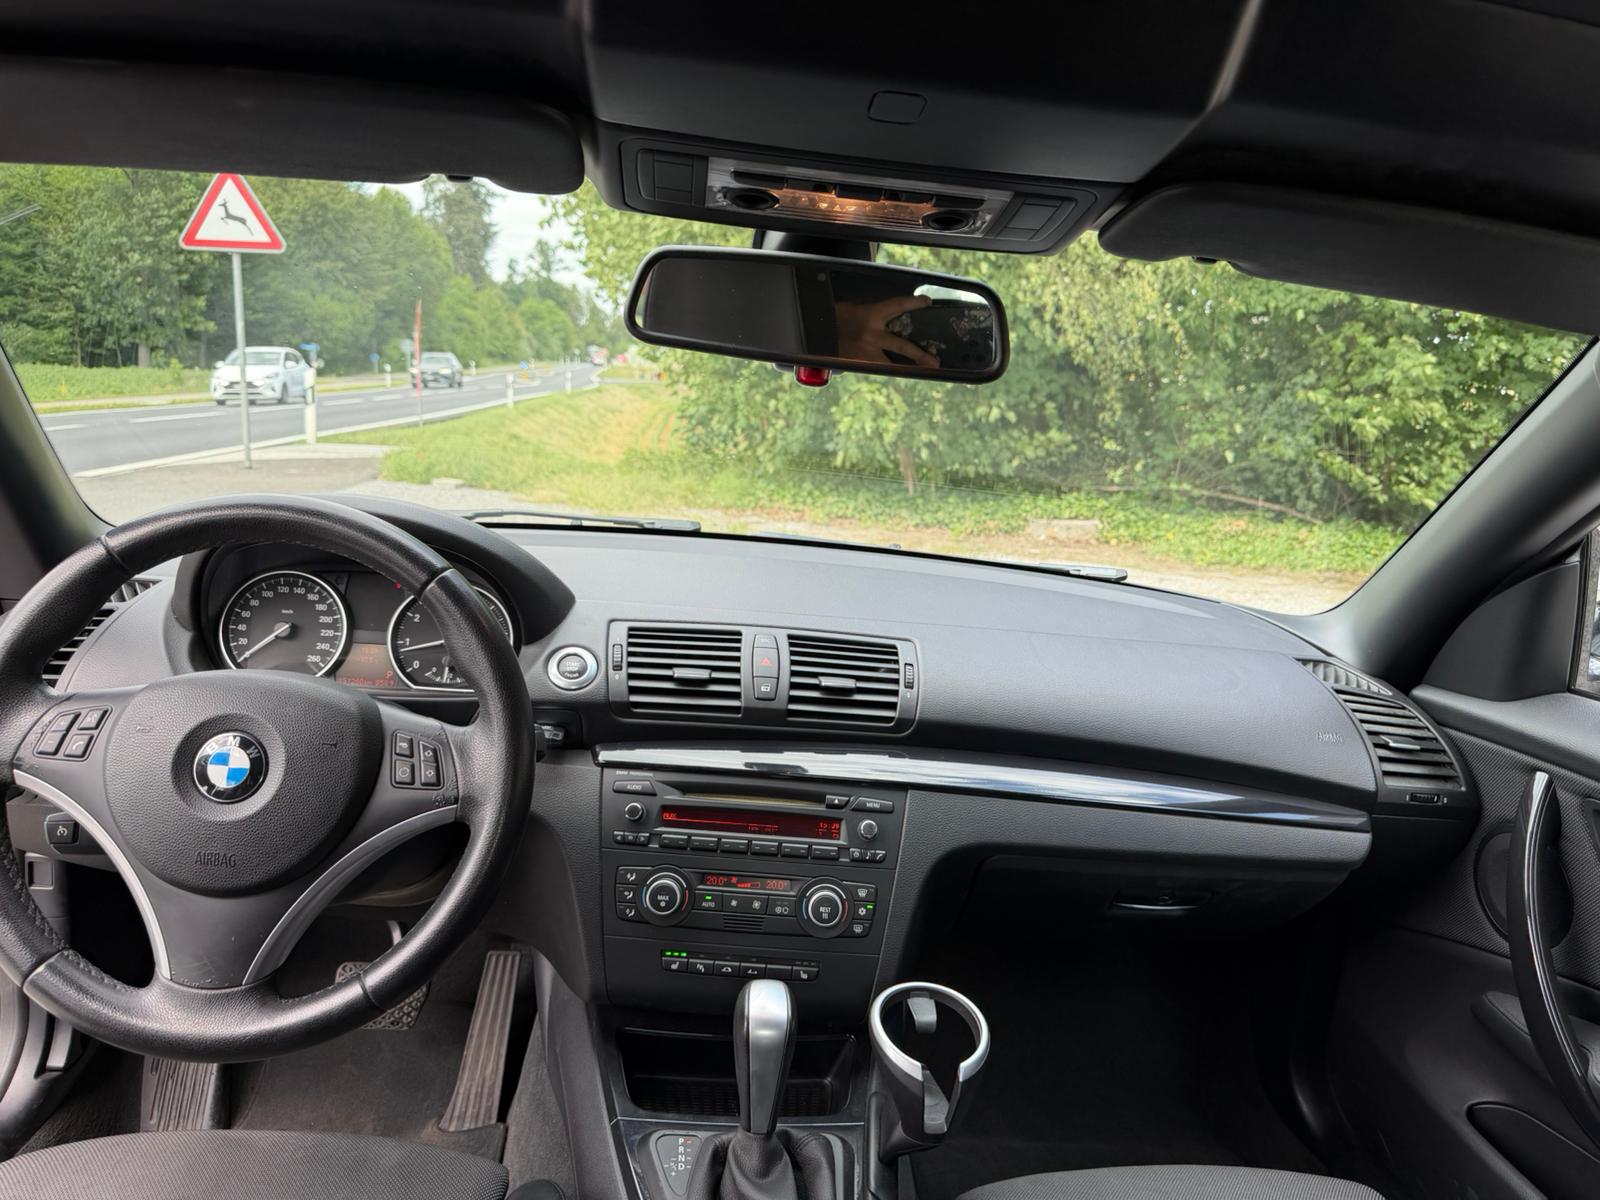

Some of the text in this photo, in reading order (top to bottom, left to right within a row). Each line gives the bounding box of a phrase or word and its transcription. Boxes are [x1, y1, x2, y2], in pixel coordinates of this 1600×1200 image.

[315, 603, 328, 611] 180
[241, 610, 251, 618] 60
[413, 614, 421, 623] 2
[238, 637, 248, 645] 20
[306, 655, 321, 663] 260
[412, 660, 420, 669] 0
[206, 735, 261, 760] BMW
[195, 851, 237, 868] AIRBAG
[678, 1137, 685, 1146] P
[678, 1145, 685, 1154] R
[678, 1154, 686, 1162] N
[677, 1162, 686, 1170] D
